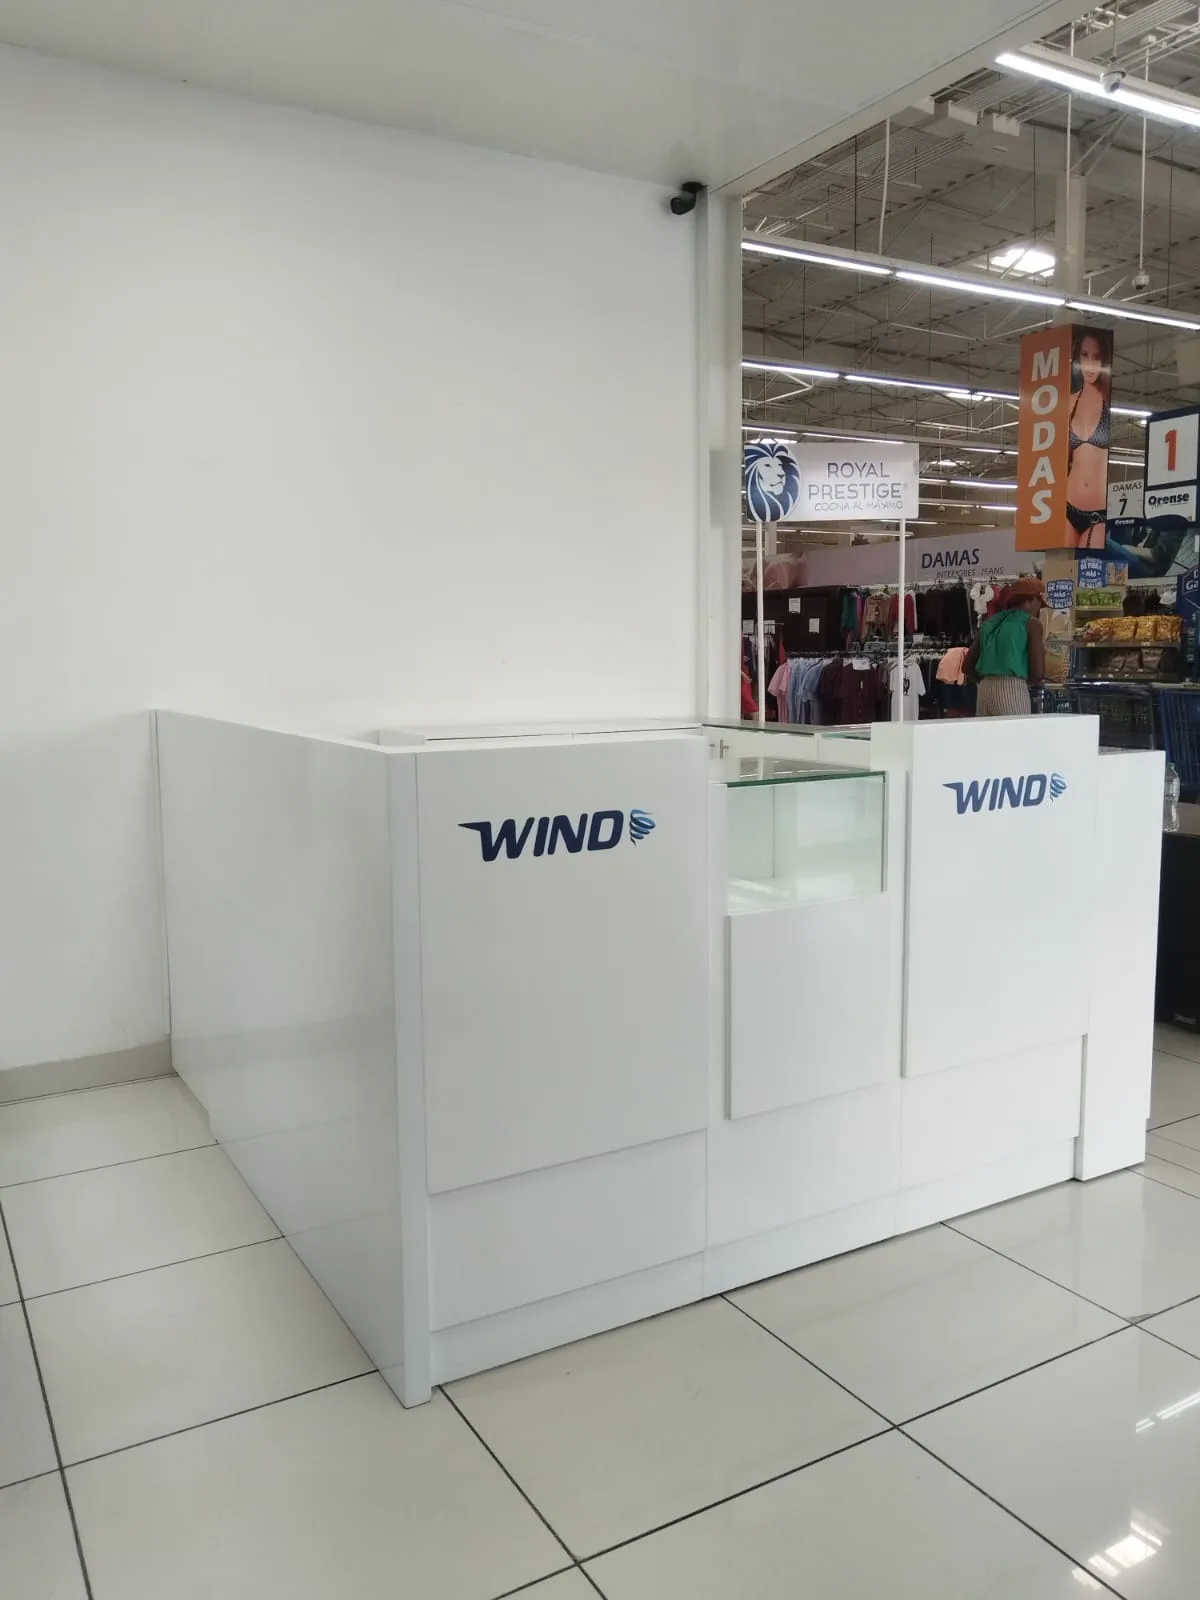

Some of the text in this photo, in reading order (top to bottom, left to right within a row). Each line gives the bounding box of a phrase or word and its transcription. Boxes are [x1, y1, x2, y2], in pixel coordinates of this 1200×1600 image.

[1028, 347, 1060, 524] MODAS
[1164, 429, 1178, 472] 1
[827, 461, 890, 478] ROYAL
[808, 482, 902, 500] PRESTIGE
[1112, 482, 1143, 493] DAMAS
[1119, 498, 1128, 516] 7
[1148, 493, 1190, 506] Orense
[921, 548, 980, 569] DAMAS
[942, 774, 1047, 815] WIND
[457, 810, 624, 862] WIND
